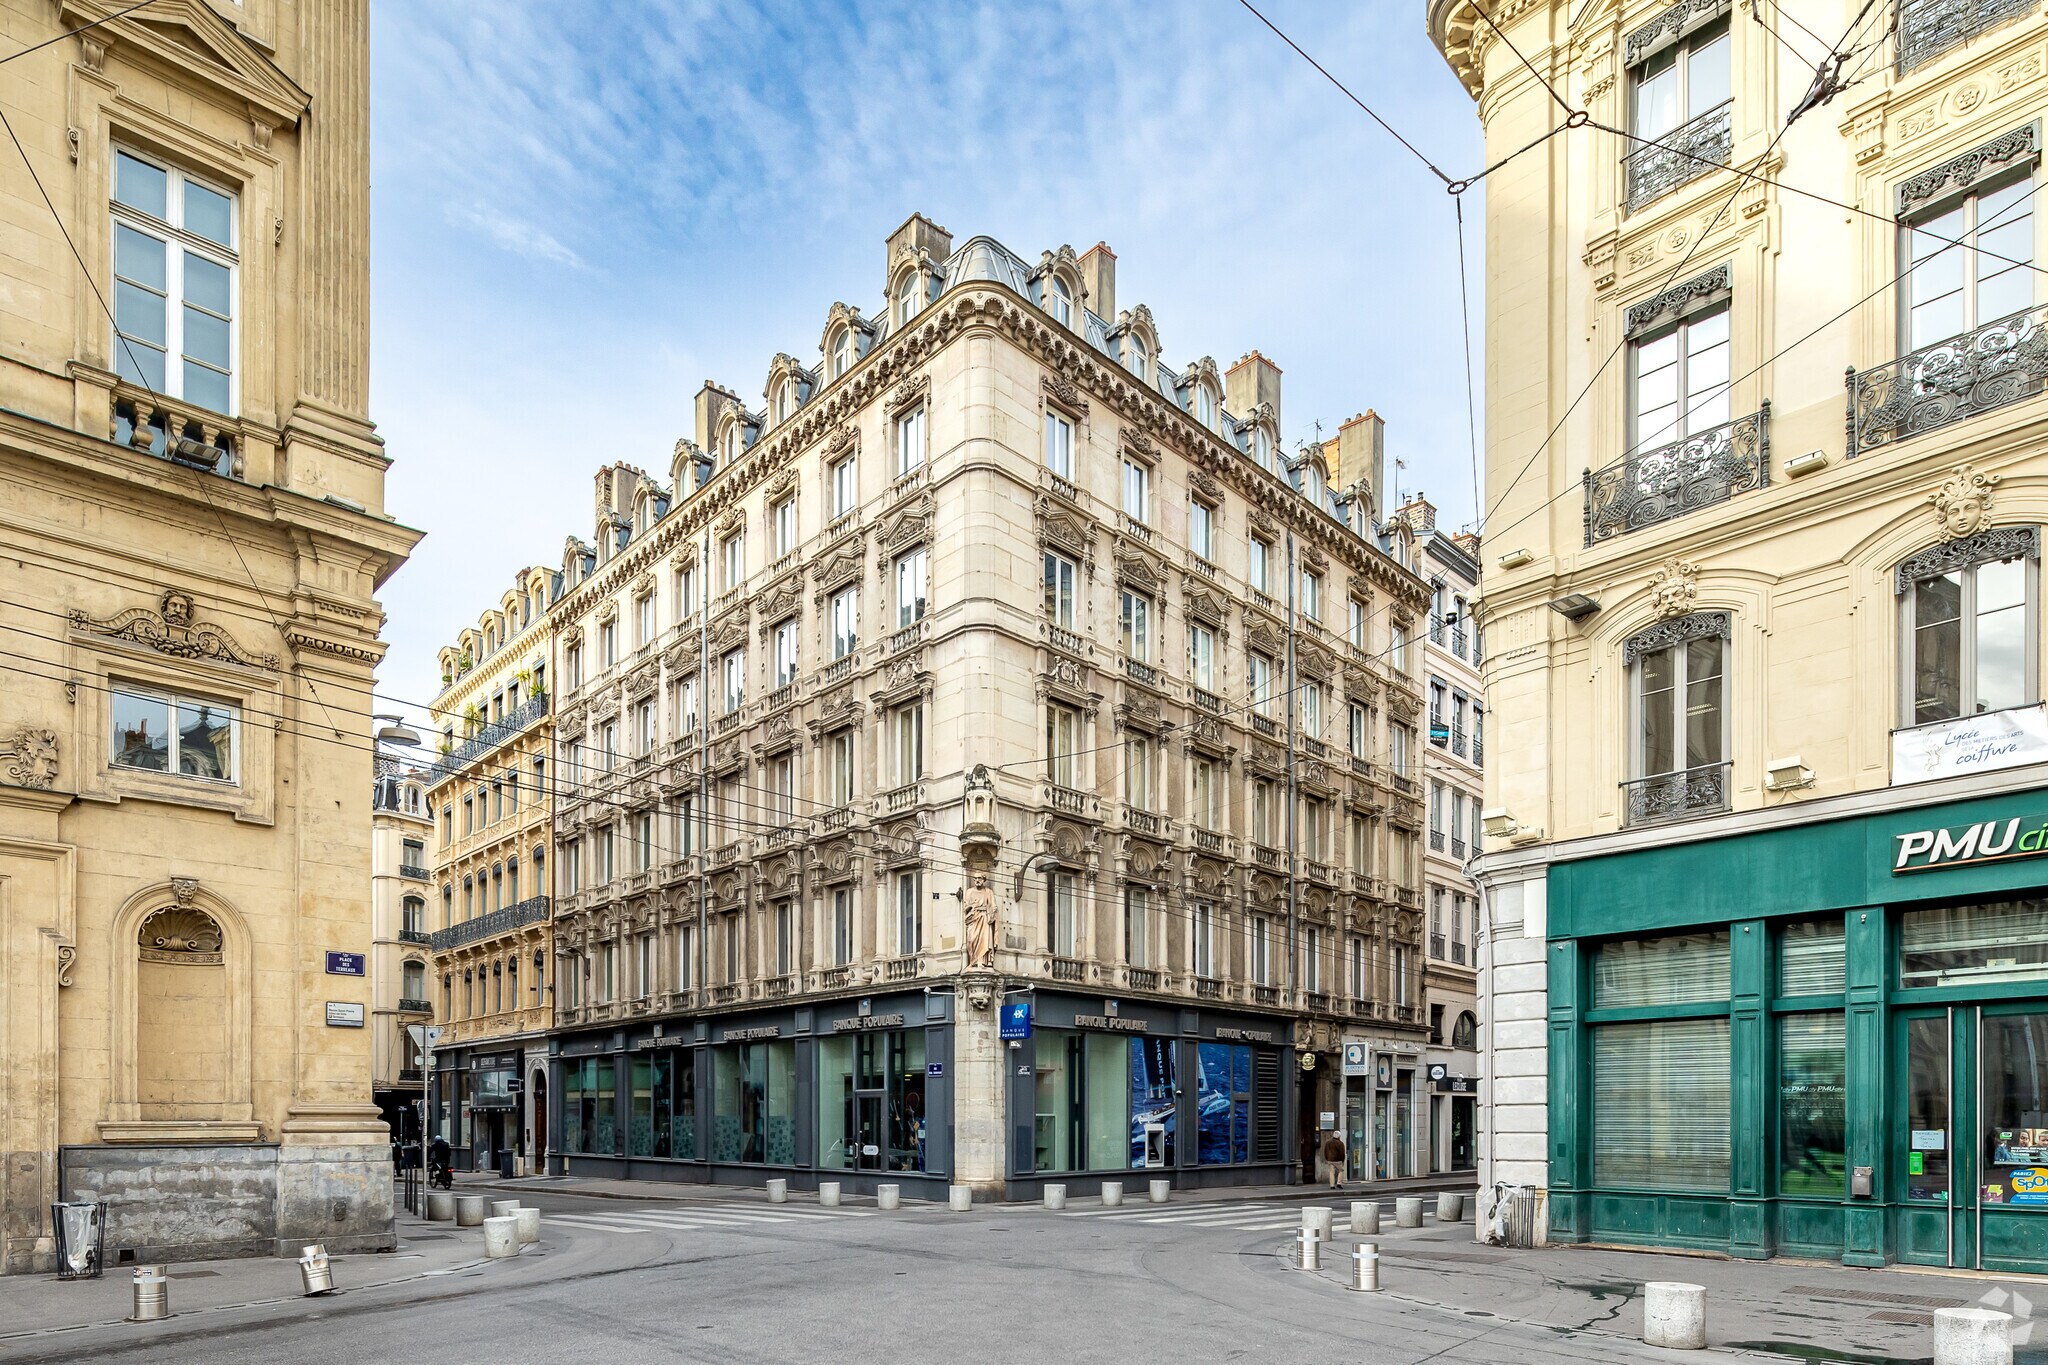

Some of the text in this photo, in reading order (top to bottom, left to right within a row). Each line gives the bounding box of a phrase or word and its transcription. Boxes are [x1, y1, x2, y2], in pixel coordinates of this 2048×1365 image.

[1945, 730, 1980, 747] Lycée
[2010, 730, 2024, 738] ARTS
[1956, 743, 2017, 764] coiffure
[1896, 817, 2021, 868] PMU
[833, 1013, 903, 1031] BANQUE POPULAIRE
[1075, 1014, 1148, 1031] BANQUE POPULAIRE
[638, 1036, 682, 1048] BANQUE POPULAIRE
[724, 1026, 779, 1041] BANQUE POPULAIRE
[1216, 1027, 1272, 1042] BANQUE OPULAIRE
